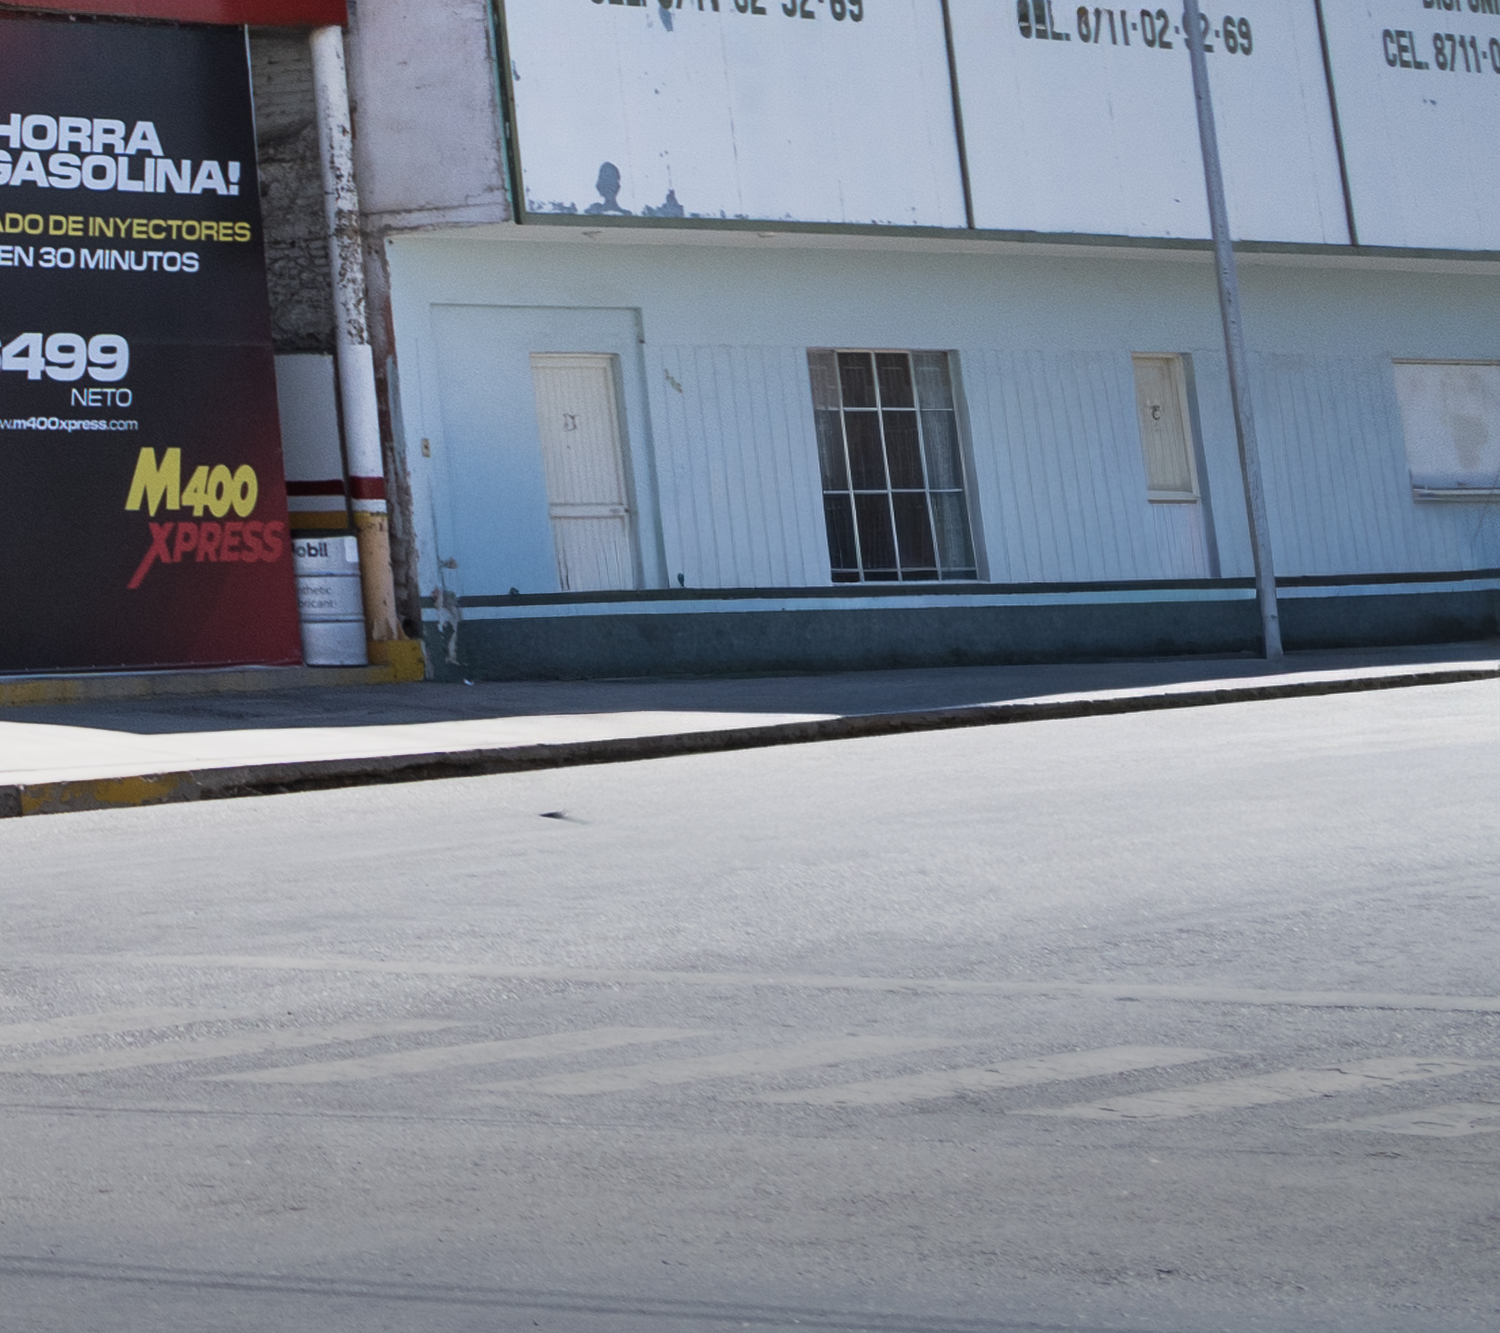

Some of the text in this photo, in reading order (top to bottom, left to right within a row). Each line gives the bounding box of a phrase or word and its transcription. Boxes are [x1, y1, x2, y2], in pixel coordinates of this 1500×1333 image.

[48, 214, 84, 237] DE
[88, 215, 252, 243] INYECTORES
[38, 247, 76, 269] 30
[79, 248, 201, 273] MINUTOS
[70, 387, 133, 408] NETO
[123, 446, 259, 518] M400
[127, 520, 286, 589] XPRESS
[293, 541, 329, 558] obil
